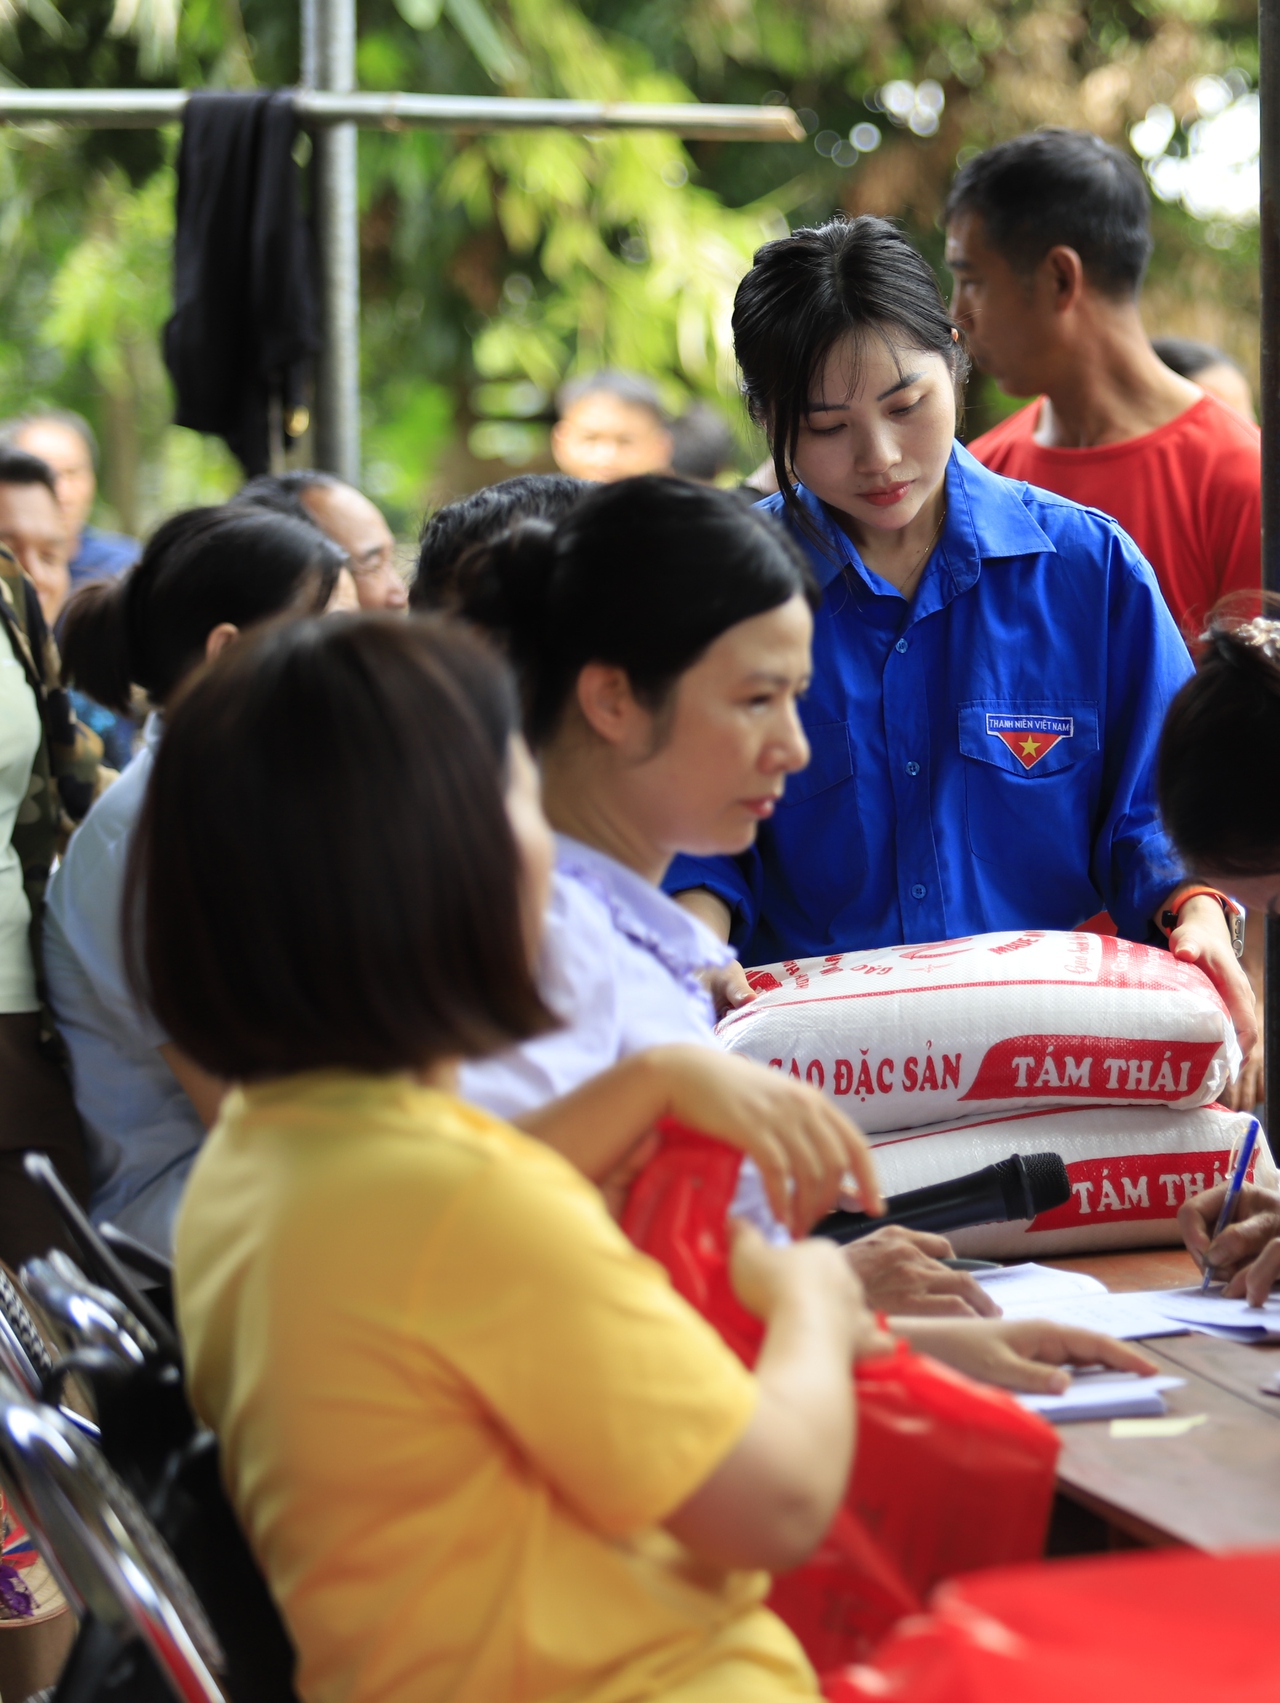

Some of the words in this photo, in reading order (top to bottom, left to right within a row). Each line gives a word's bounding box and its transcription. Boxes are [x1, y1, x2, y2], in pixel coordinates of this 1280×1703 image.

[989, 719, 1014, 729] THANH
[1015, 718, 1033, 729] NIÊN
[1034, 719, 1052, 731] VIỆT
[1052, 722, 1070, 732] NAM
[987, 937, 1039, 955] MADE
[833, 1048, 894, 1102] ĐẶC
[902, 1040, 961, 1093] SẢN
[1012, 1045, 1093, 1087] TÁM
[1103, 1051, 1191, 1092] THÁI
[1072, 1169, 1150, 1214] TÁM
[1159, 1161, 1224, 1206] THÁ
